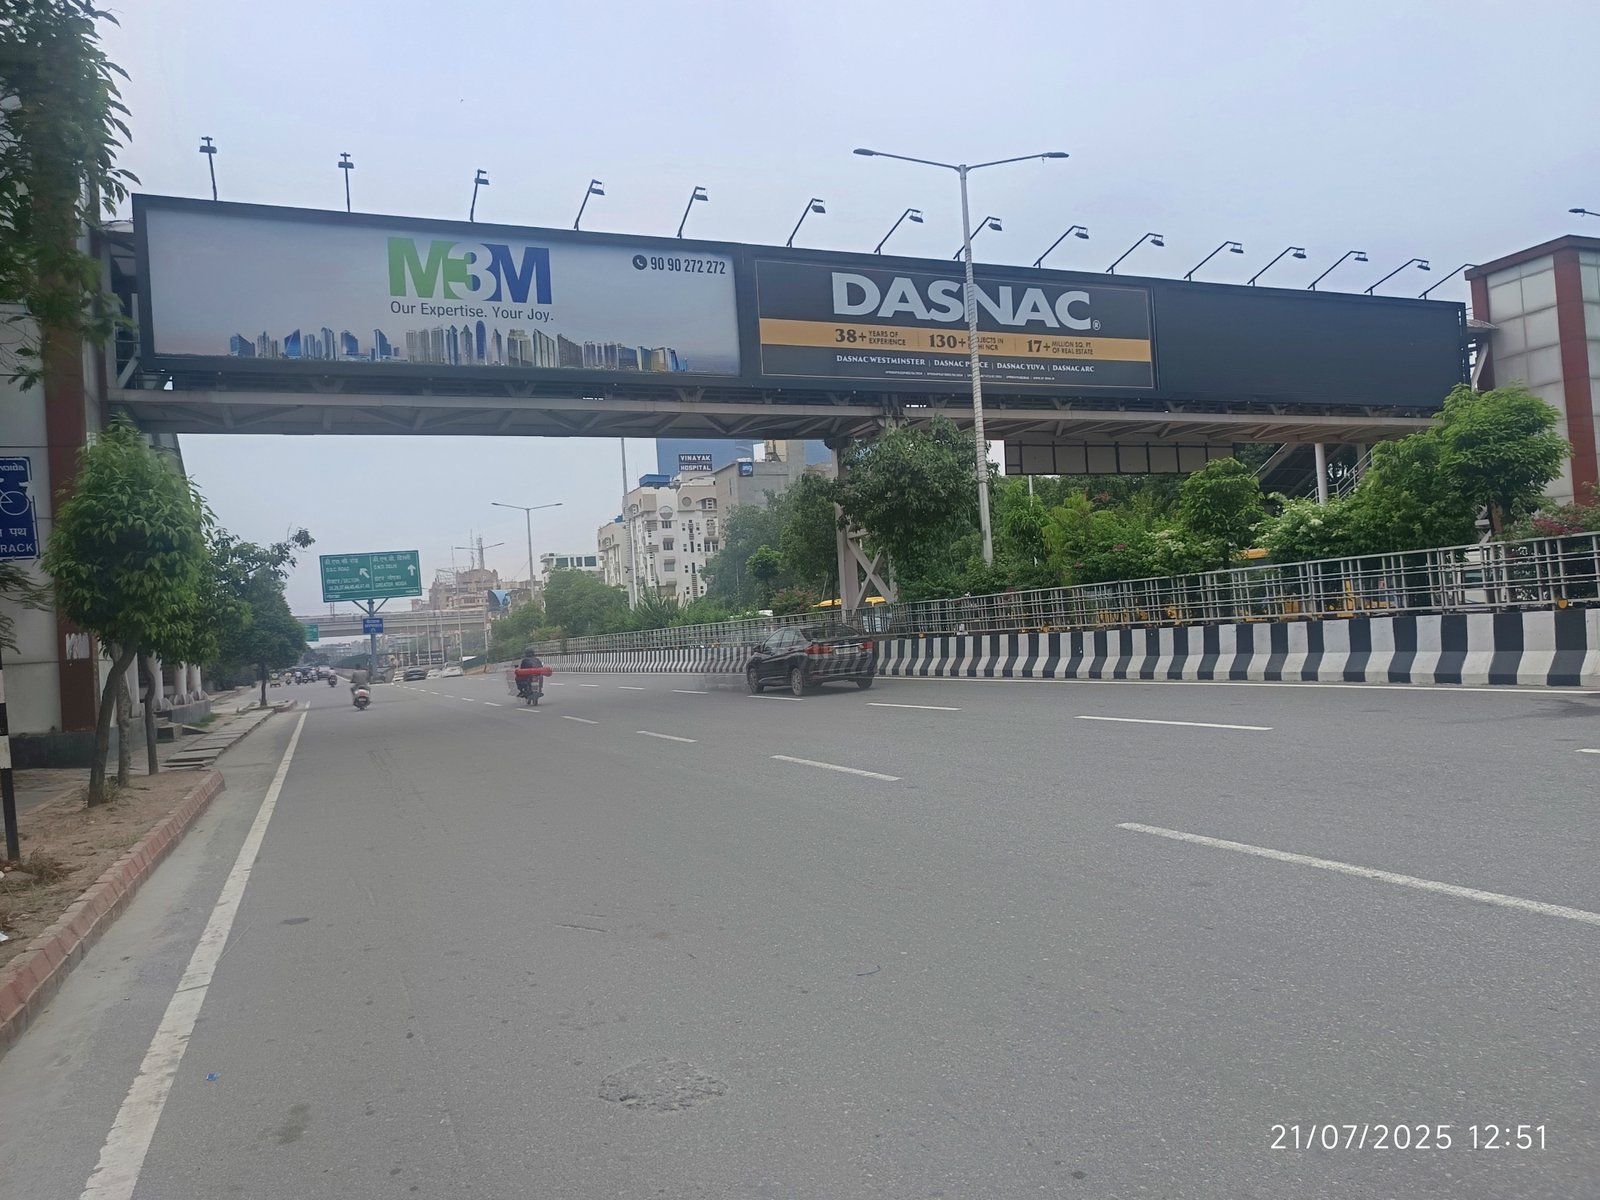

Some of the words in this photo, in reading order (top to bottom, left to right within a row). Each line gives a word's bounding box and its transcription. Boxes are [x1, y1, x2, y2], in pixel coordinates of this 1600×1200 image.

[388, 236, 552, 304] M3M
[650, 256, 664, 271] 90
[667, 257, 682, 272] 90
[684, 258, 704, 273] 272
[706, 260, 726, 275] 272
[831, 272, 1091, 330] DASNAC
[390, 300, 416, 314] Our
[420, 303, 488, 318] Expertise.
[492, 305, 524, 320] Your
[527, 308, 554, 323] Joy.
[834, 328, 867, 344] 38+
[868, 330, 888, 338] YEARS
[868, 337, 906, 346] EXPERIENCE
[929, 333, 966, 349] 130+
[1026, 339, 1051, 353] 17+
[1052, 340, 1074, 348] MILLION
[836, 355, 868, 363] DASNAC
[870, 356, 926, 366] WESTMINSTER
[934, 359, 964, 368] DASNAC
[996, 362, 1026, 370] DASNAC
[1026, 363, 1046, 371] YUVA
[1052, 364, 1080, 372] DASNAC
[1080, 365, 1095, 373] ARC
[9, 527, 28, 537] पथ
[0, 543, 34, 553] RACK
